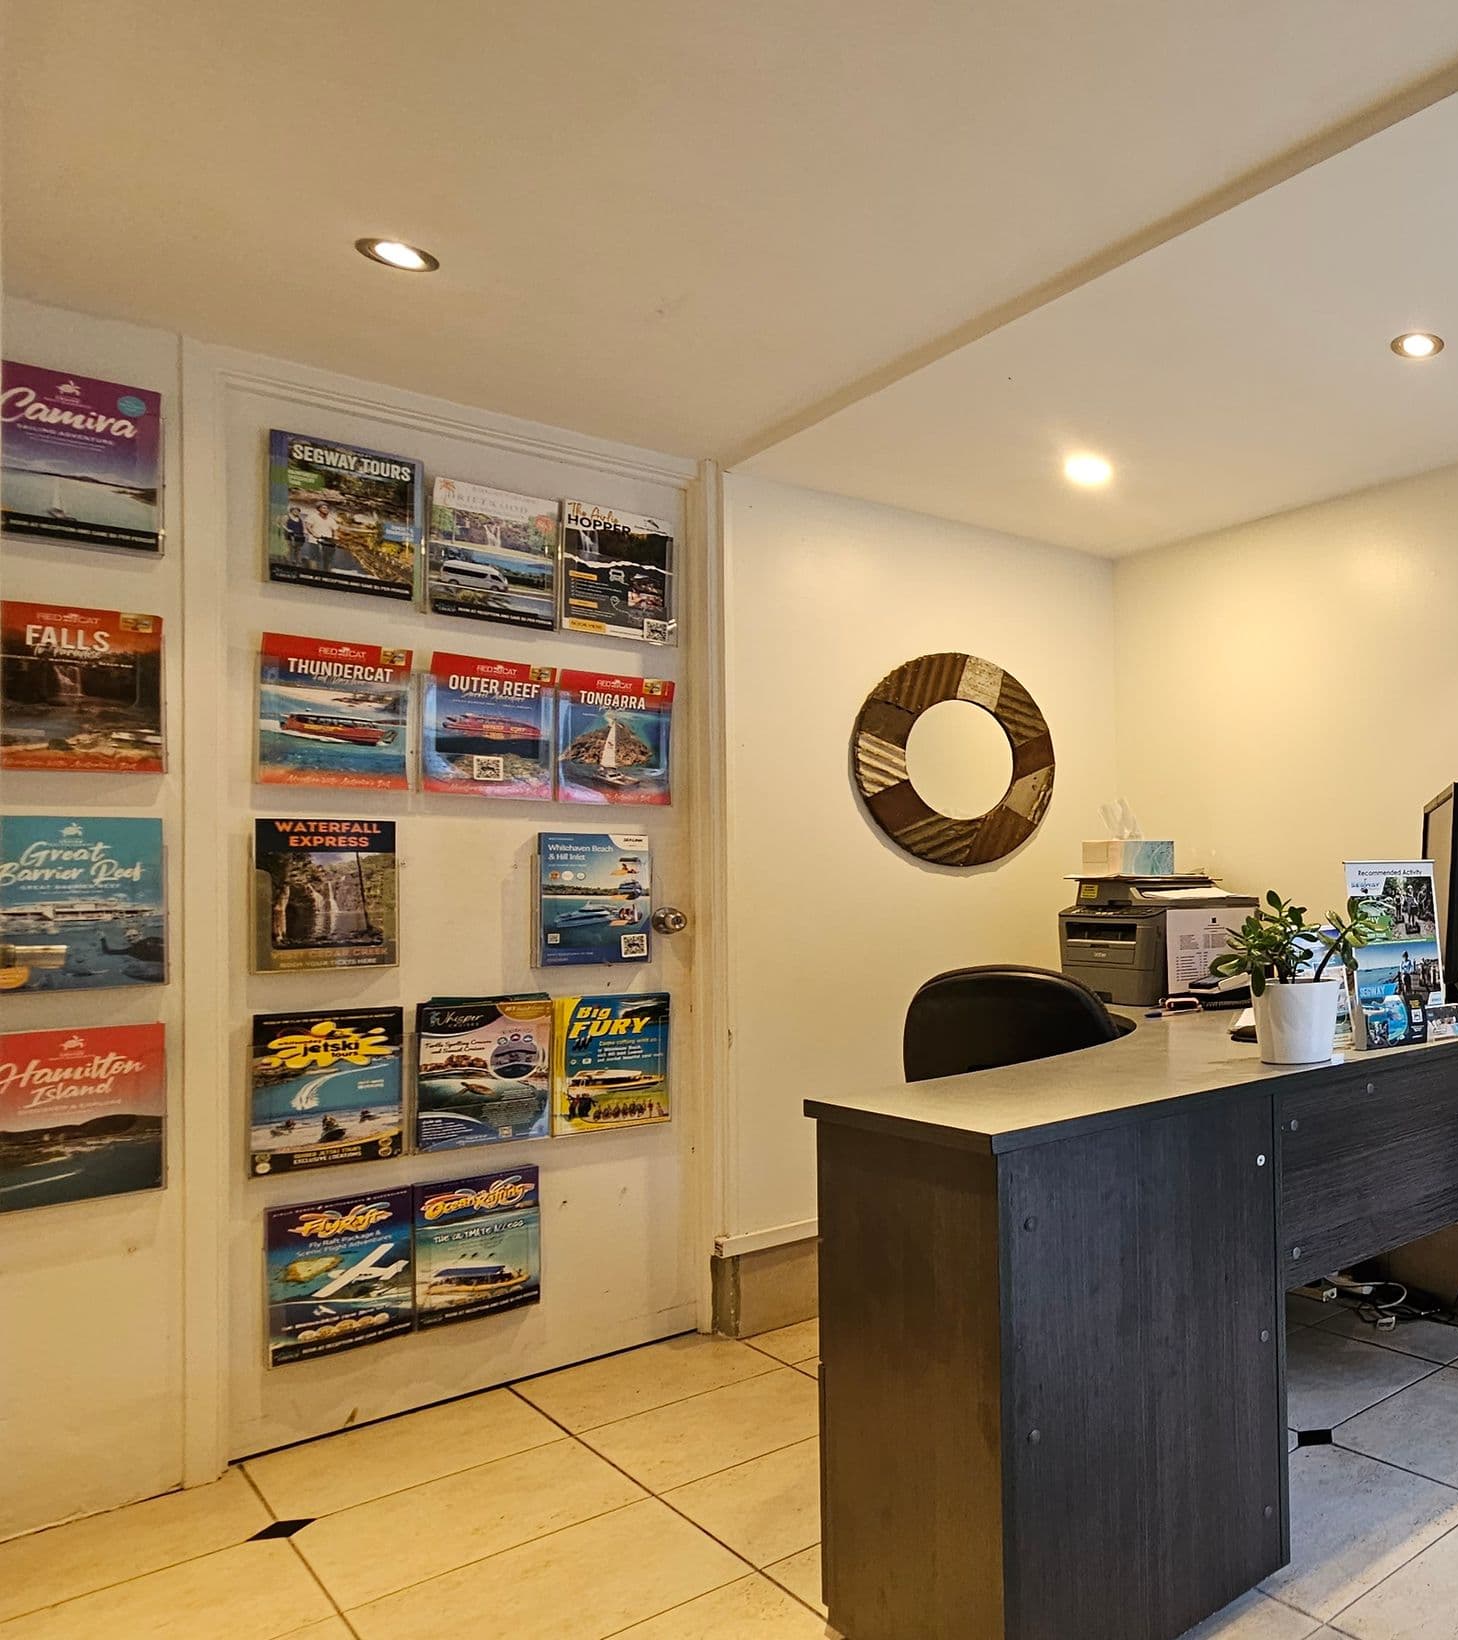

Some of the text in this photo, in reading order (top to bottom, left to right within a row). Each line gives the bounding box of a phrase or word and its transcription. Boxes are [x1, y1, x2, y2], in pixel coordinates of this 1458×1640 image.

[0, 386, 137, 438] Camira
[292, 444, 412, 482] SEGWAY TOURS
[568, 514, 632, 535] HOPPER
[26, 624, 111, 653] FALLS
[288, 657, 394, 683] THUNDERCAT
[448, 674, 541, 699] OUTER REEF
[579, 690, 646, 710] TONGARRA
[274, 821, 382, 834] WATERFALL
[288, 835, 370, 847] EXPRESS
[547, 843, 614, 853] Whitehaven Beach
[20, 841, 112, 867] Great
[548, 852, 586, 861] & Hill Inlet
[0, 859, 147, 887] Barrier Reef
[352, 947, 388, 956] CREEK
[1360, 986, 1385, 997] SEGWAY
[437, 1010, 484, 1026] Whisper
[576, 1006, 612, 1020] Big
[568, 1016, 651, 1039] FURY
[303, 1040, 360, 1057] jetski
[0, 1051, 145, 1094] Hamilton
[21, 1077, 115, 1109] Island
[293, 1155, 327, 1165] EXCLUSIVE
[296, 1234, 392, 1258] Scenic Flight Adventures
[309, 1240, 322, 1249] Fly
